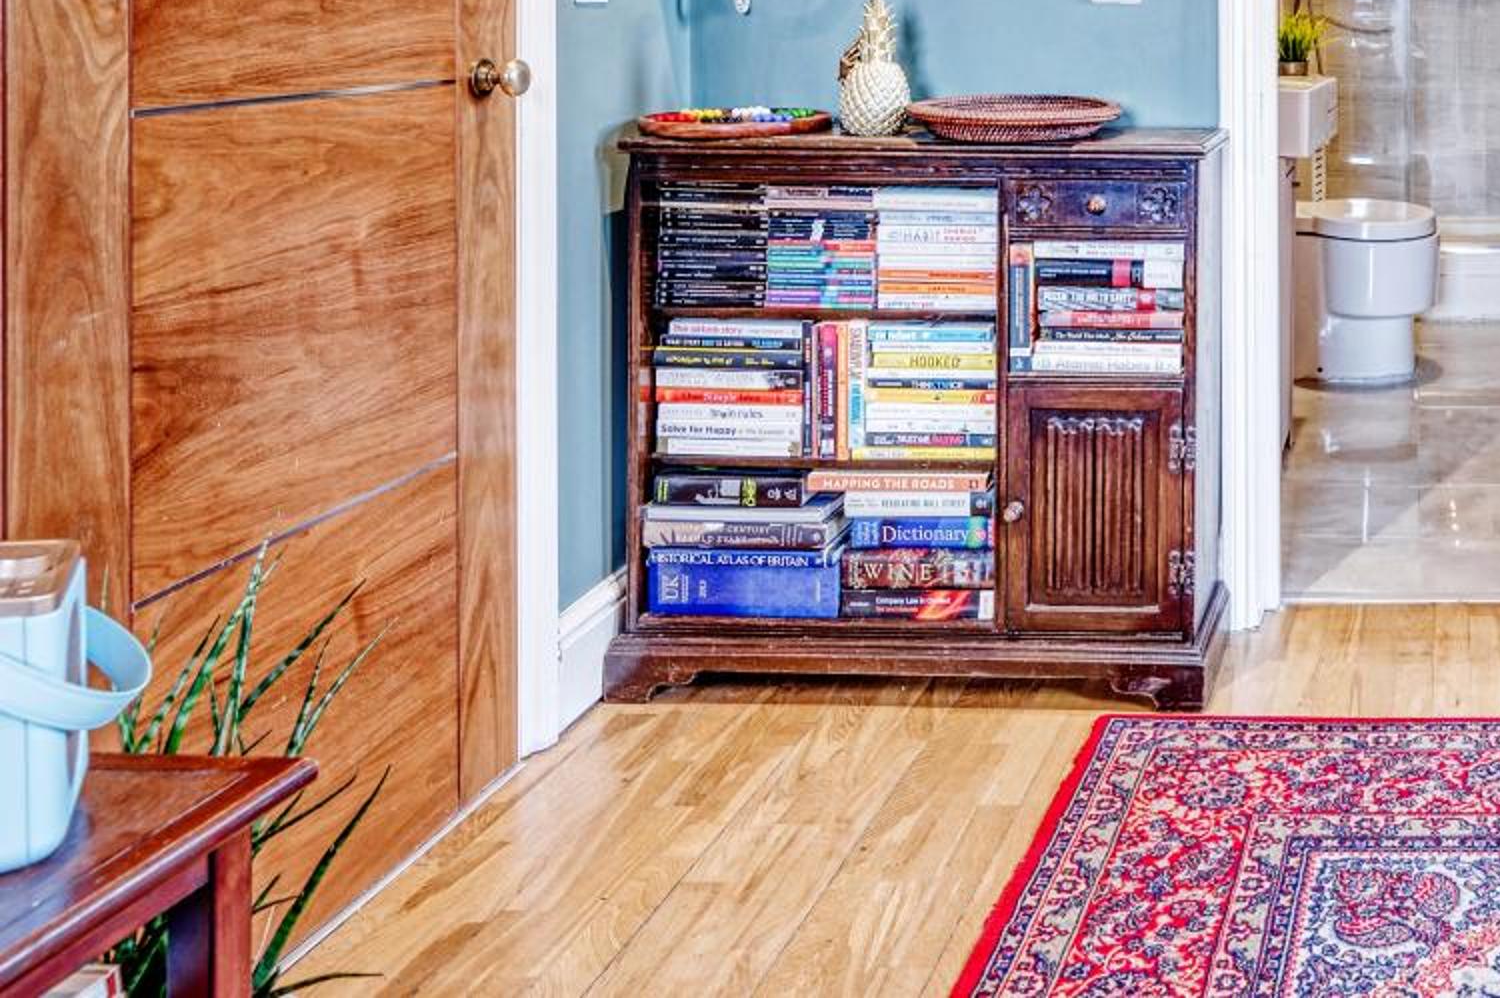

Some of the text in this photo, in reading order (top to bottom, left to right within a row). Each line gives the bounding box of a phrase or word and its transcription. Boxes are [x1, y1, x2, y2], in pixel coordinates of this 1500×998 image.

[909, 354, 961, 369] HOOKED
[661, 424, 736, 437] Solve for Happy
[823, 479, 955, 490] MAPPING THE ROADS
[728, 525, 770, 535] CENTURY
[881, 525, 970, 545] Dictionary
[651, 551, 810, 567] HISTORICAL ATLAS OF BRITAIN
[863, 562, 935, 581] WINE
[663, 573, 680, 600] UK
[875, 596, 904, 606] Company
[905, 596, 919, 605] Law
